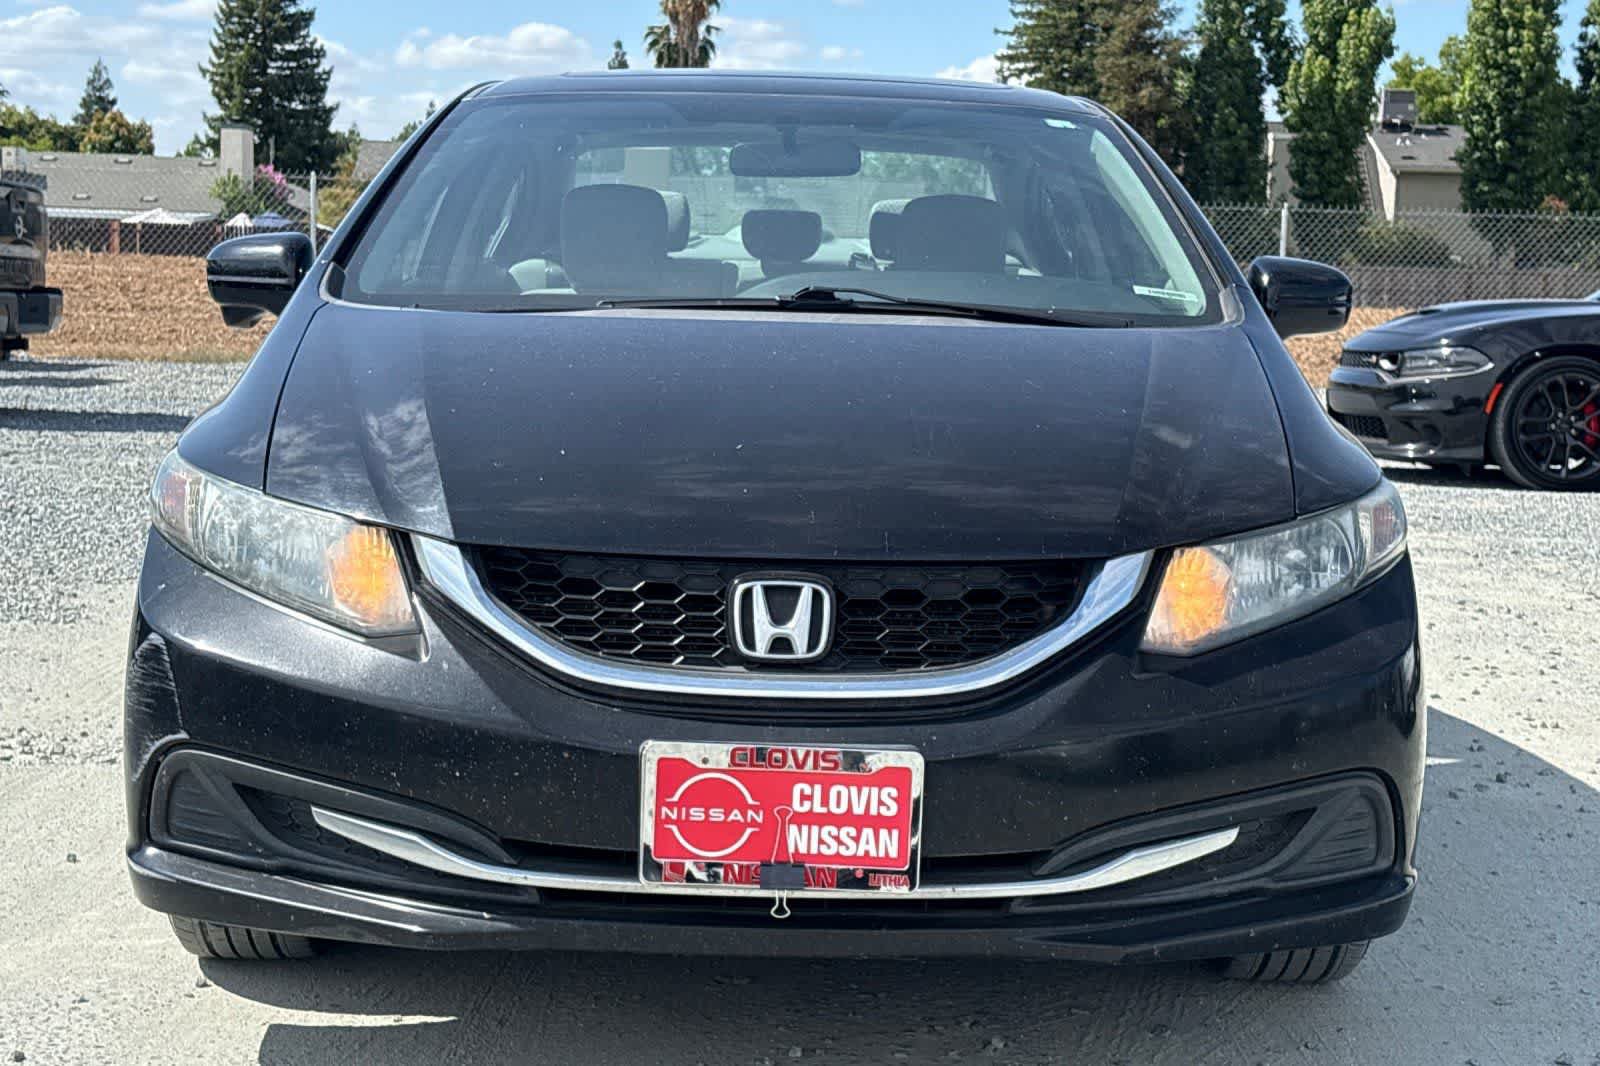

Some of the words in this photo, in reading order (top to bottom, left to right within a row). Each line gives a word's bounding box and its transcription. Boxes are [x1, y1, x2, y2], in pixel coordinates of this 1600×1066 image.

[729, 745, 841, 770] CLOVIS
[792, 782, 898, 817] CLOVIS
[661, 806, 763, 824] NISSAN
[788, 824, 899, 859] NISSAN
[723, 864, 837, 888] NIAN
